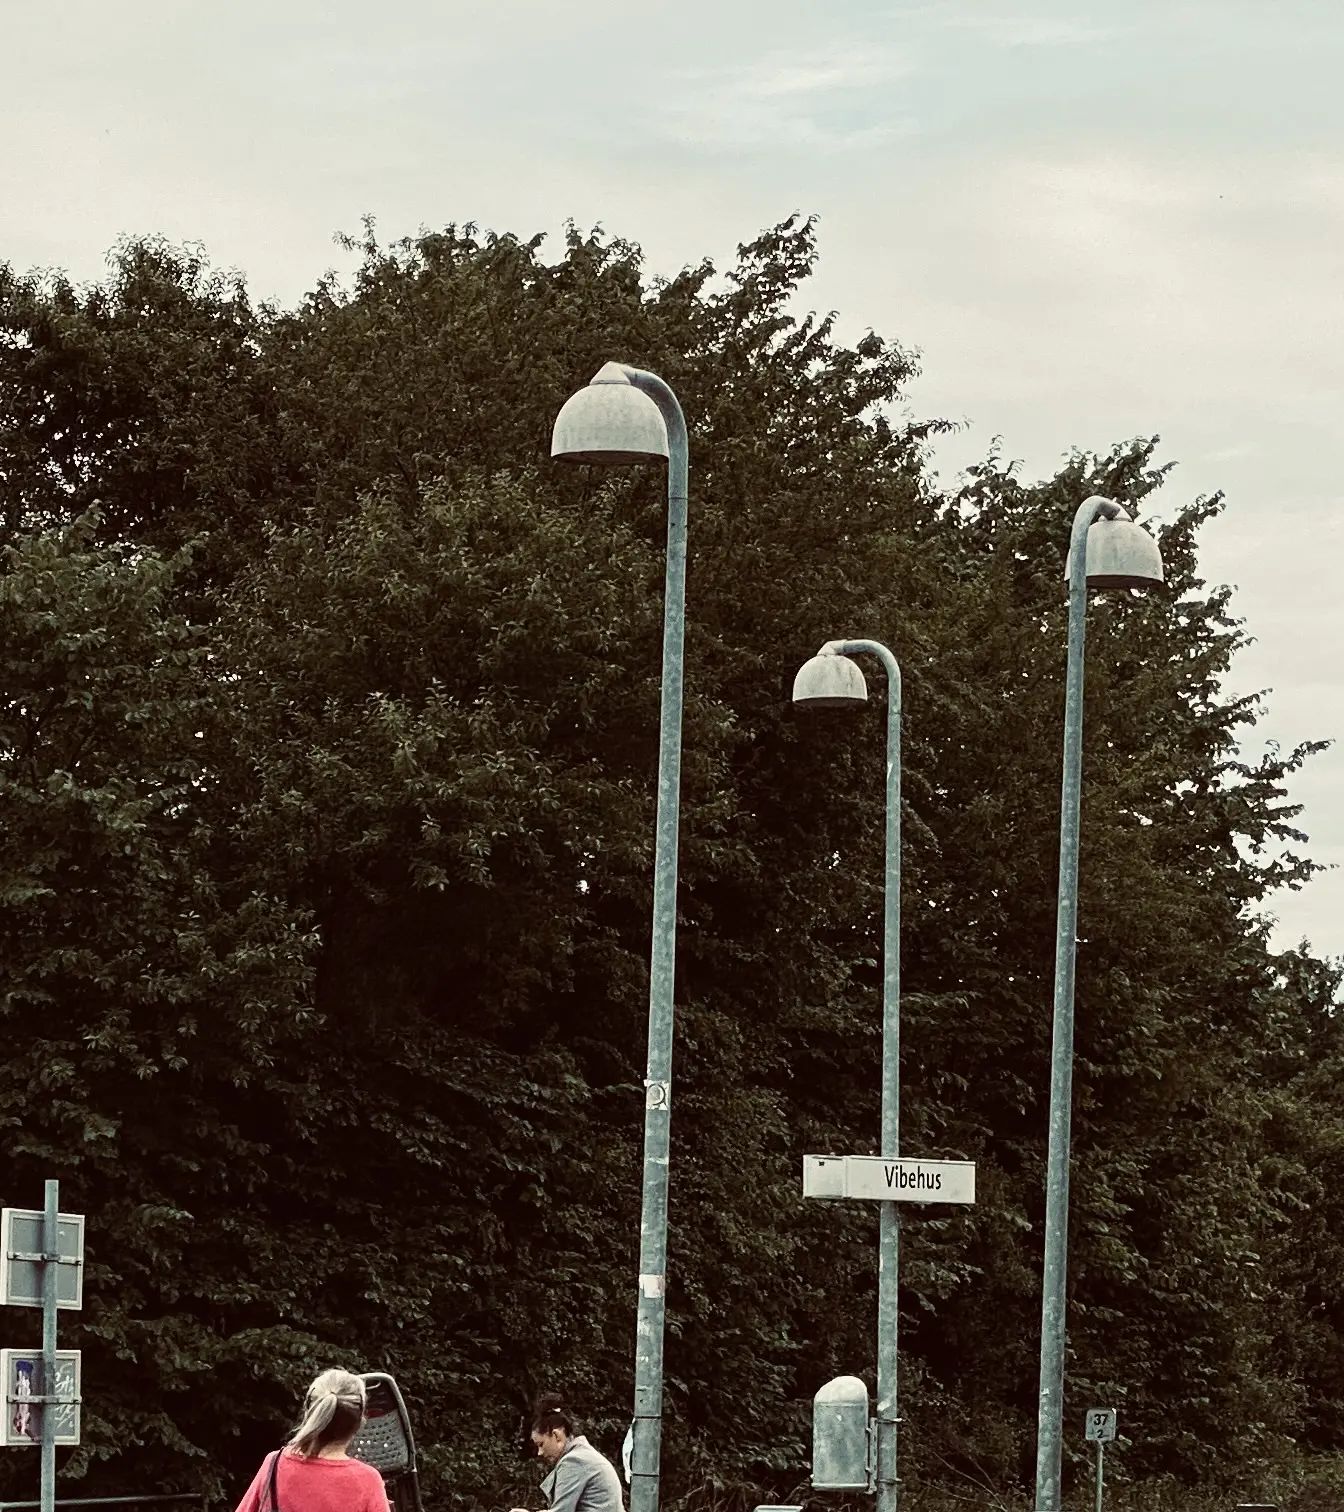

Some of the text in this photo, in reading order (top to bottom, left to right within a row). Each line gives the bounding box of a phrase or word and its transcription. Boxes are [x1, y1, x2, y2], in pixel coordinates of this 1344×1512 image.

[884, 1164, 942, 1190] Vibehus
[1093, 1413, 1108, 1426] 37
[1096, 1428, 1104, 1439] 2
